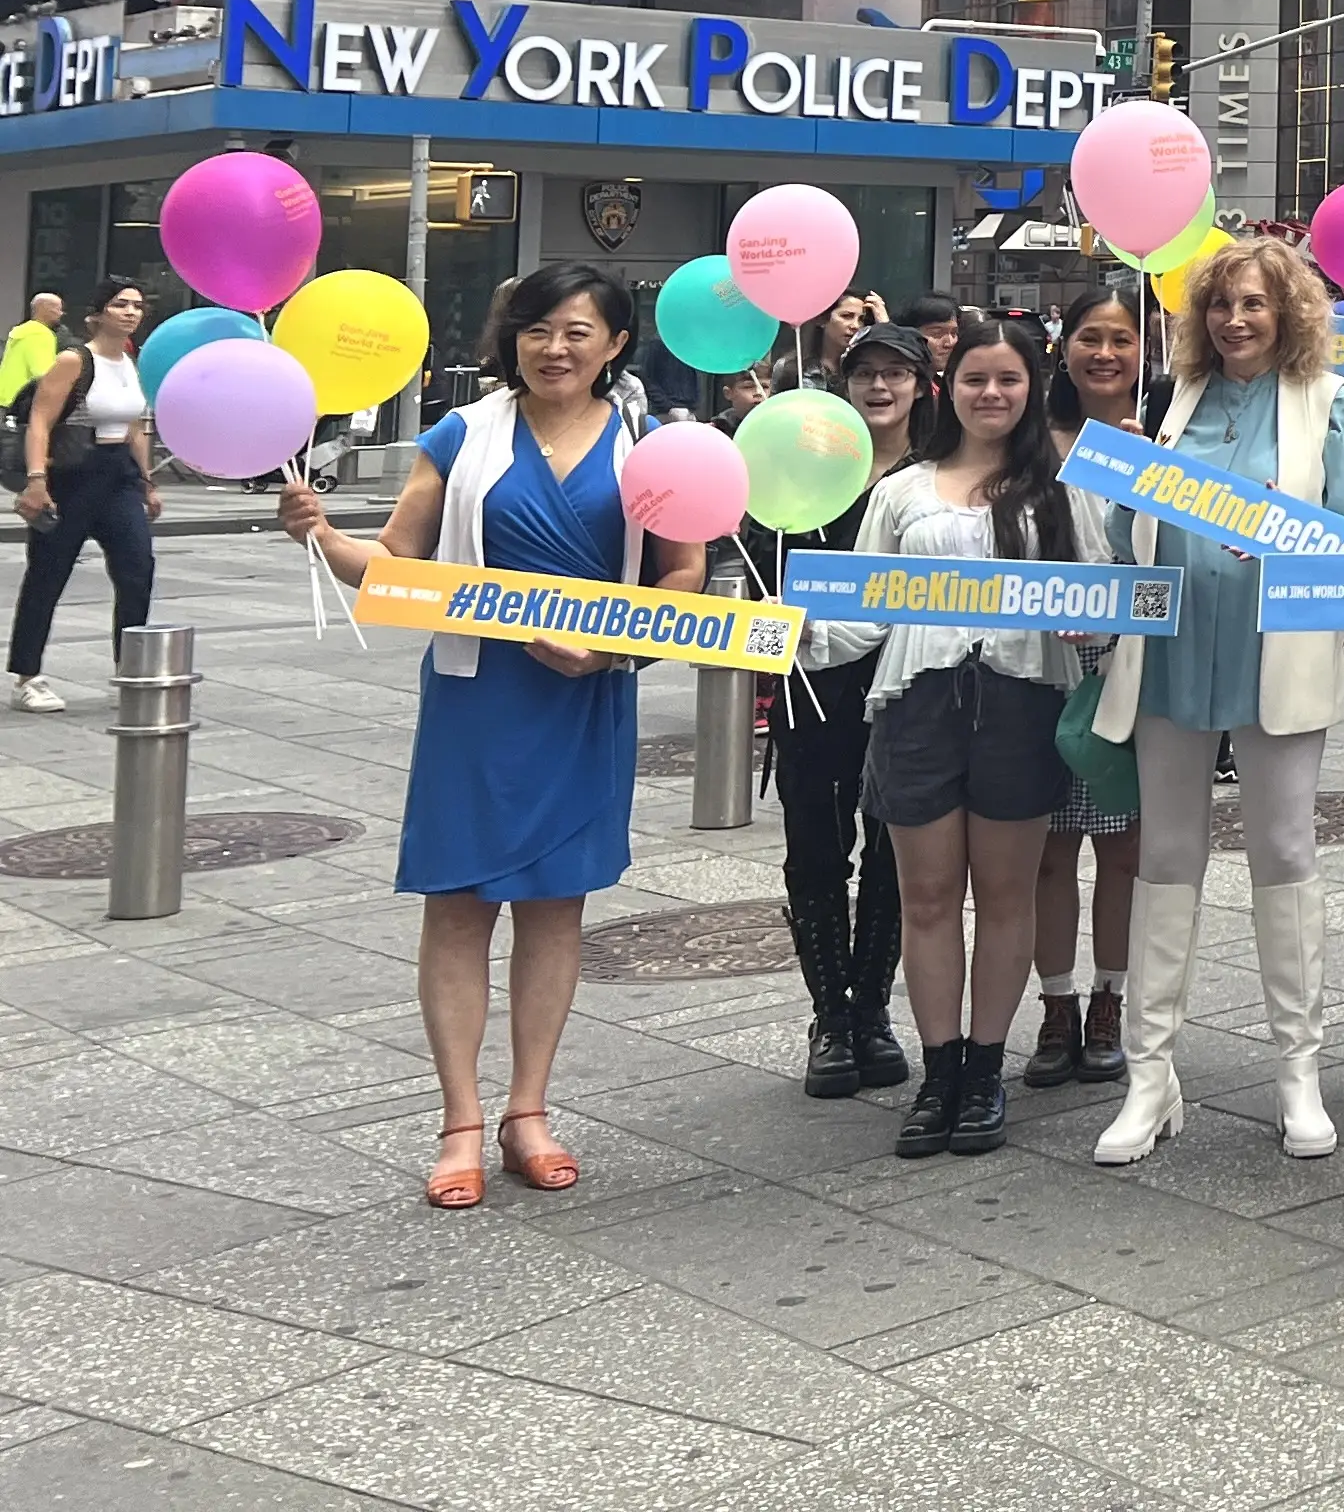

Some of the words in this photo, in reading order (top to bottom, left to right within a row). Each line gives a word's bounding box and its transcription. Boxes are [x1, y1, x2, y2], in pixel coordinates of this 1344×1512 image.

[33, 15, 112, 112] DEPT
[450, 0, 669, 110] YORK
[690, 17, 924, 122] POLICE
[949, 37, 1116, 128] DEPT
[1108, 55, 1121, 69] 43
[1217, 31, 1252, 174] TIMES
[1214, 207, 1247, 231] 3
[738, 237, 788, 250] GanJing
[739, 246, 807, 260] World.com
[861, 569, 1119, 619] #BeKindBeCool
[1267, 585, 1288, 599] GAN
[1289, 585, 1311, 599] JING
[1312, 585, 1344, 599] WORLD
[446, 582, 736, 651] #BeKindBeCool
